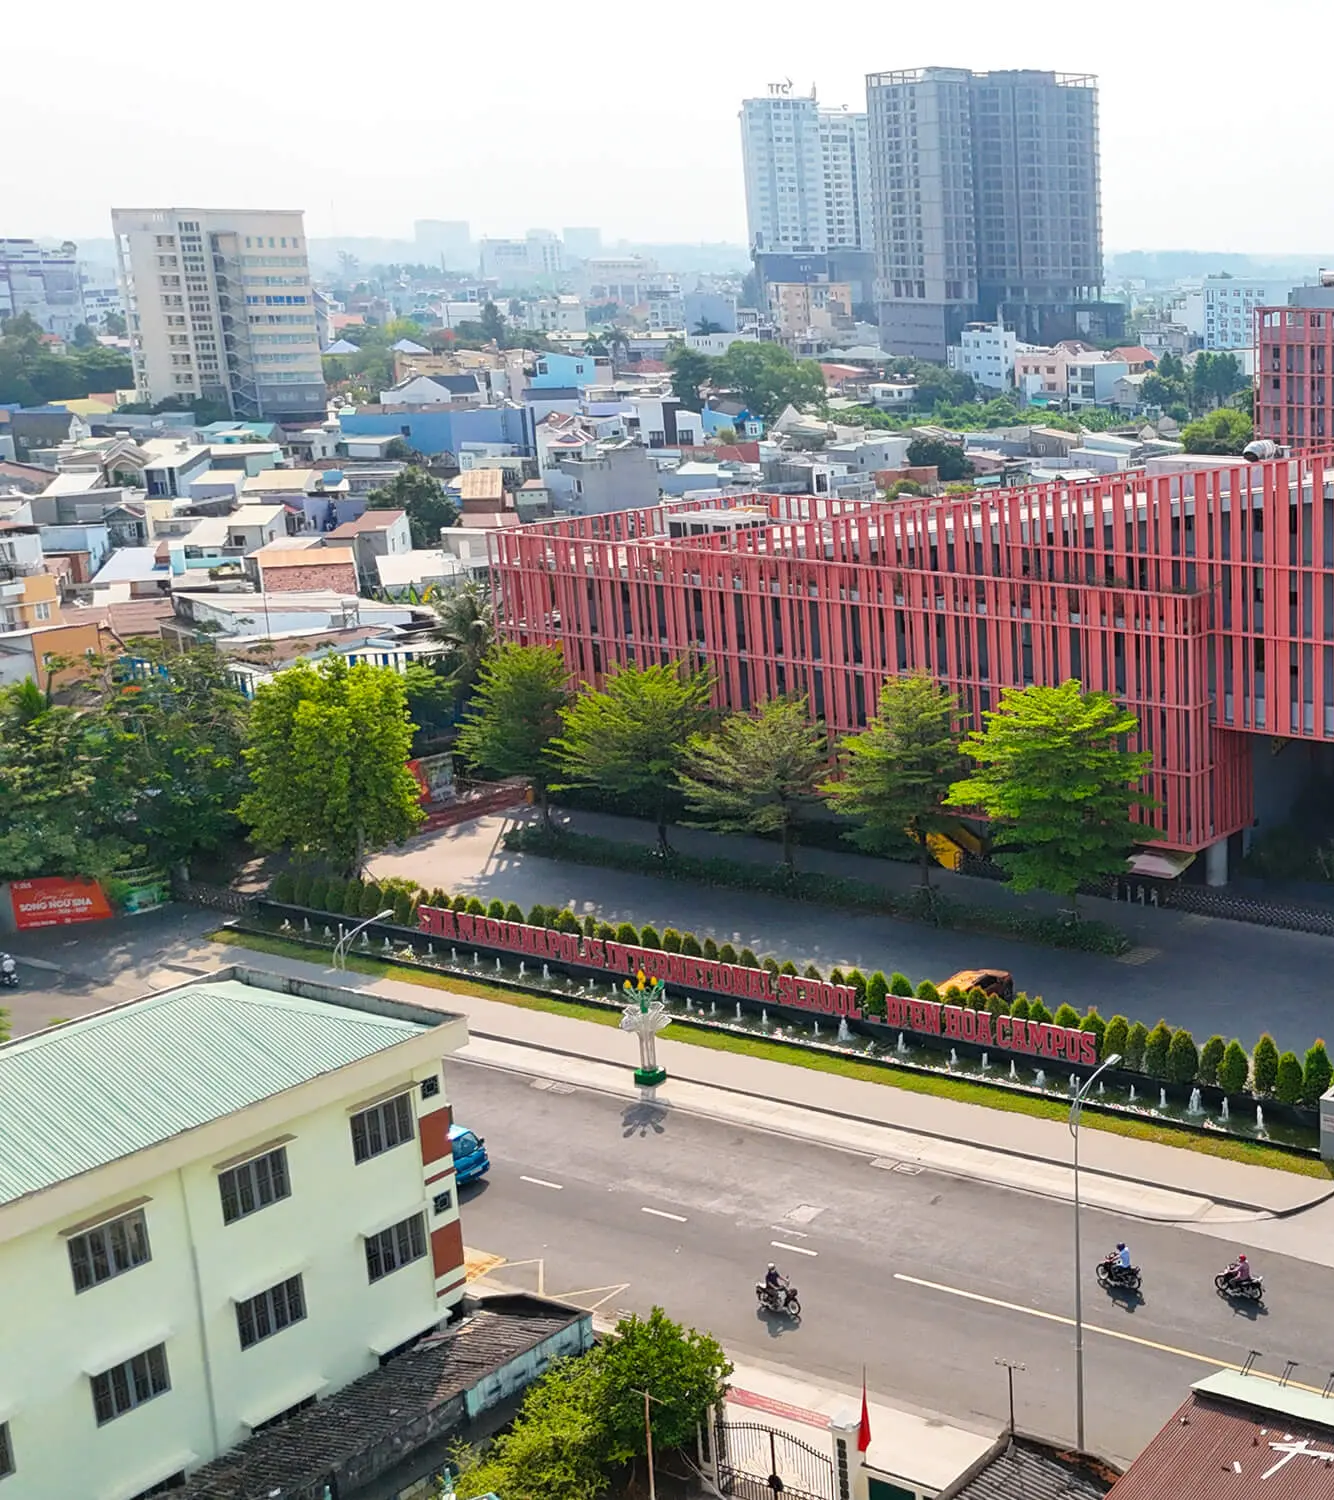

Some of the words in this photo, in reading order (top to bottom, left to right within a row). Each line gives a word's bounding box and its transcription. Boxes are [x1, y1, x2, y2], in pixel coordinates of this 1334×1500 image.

[768, 83, 790, 95] TTC
[417, 904, 455, 939] SNA
[456, 911, 604, 968] MARIANAPOLIS
[605, 940, 777, 1001] INTERNATIONAL
[779, 974, 862, 1019] SCHOOL
[944, 1004, 993, 1046] HOA
[997, 1014, 1097, 1065] CAMPUS
